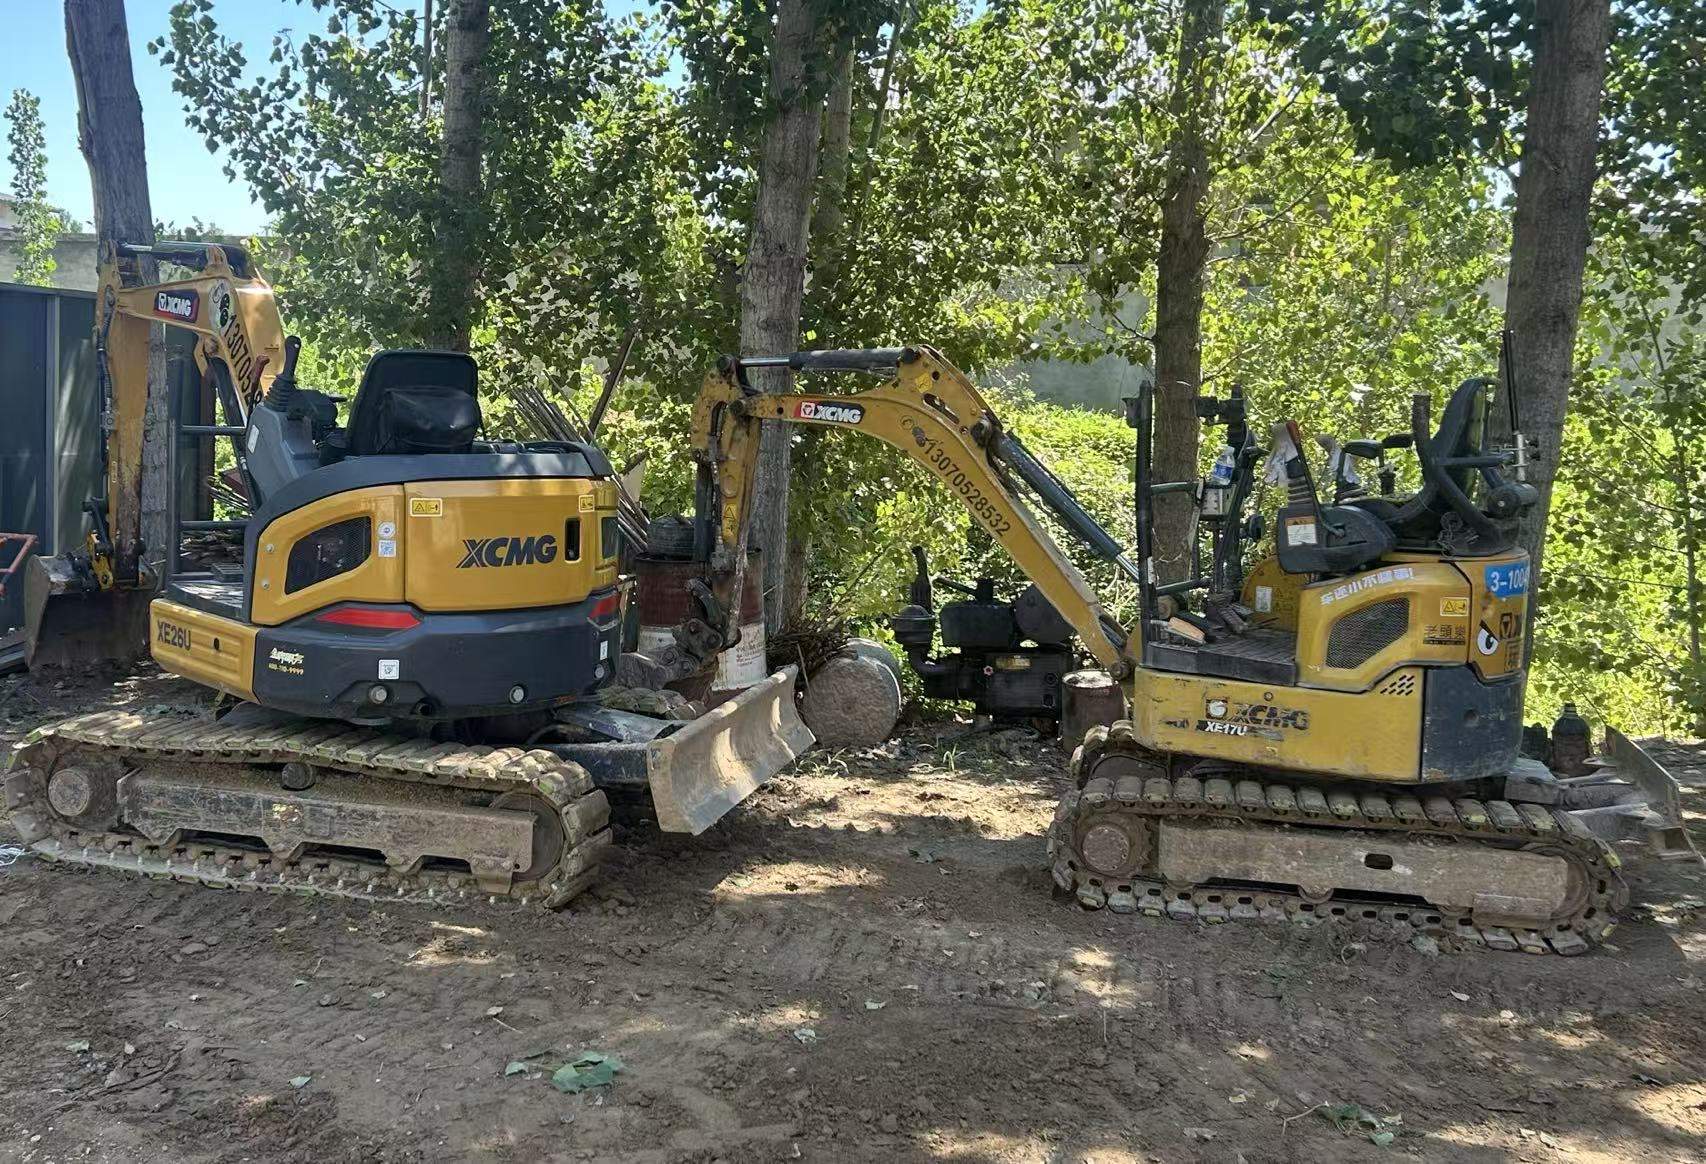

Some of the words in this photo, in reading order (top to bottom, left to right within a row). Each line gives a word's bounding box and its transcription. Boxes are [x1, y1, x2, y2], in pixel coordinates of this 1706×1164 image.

[814, 405, 861, 424] XCMG
[924, 441, 1011, 537] 13070528532
[456, 534, 558, 569] XCMG
[157, 620, 191, 651] XE26U
[1205, 720, 1248, 736] XE17U
